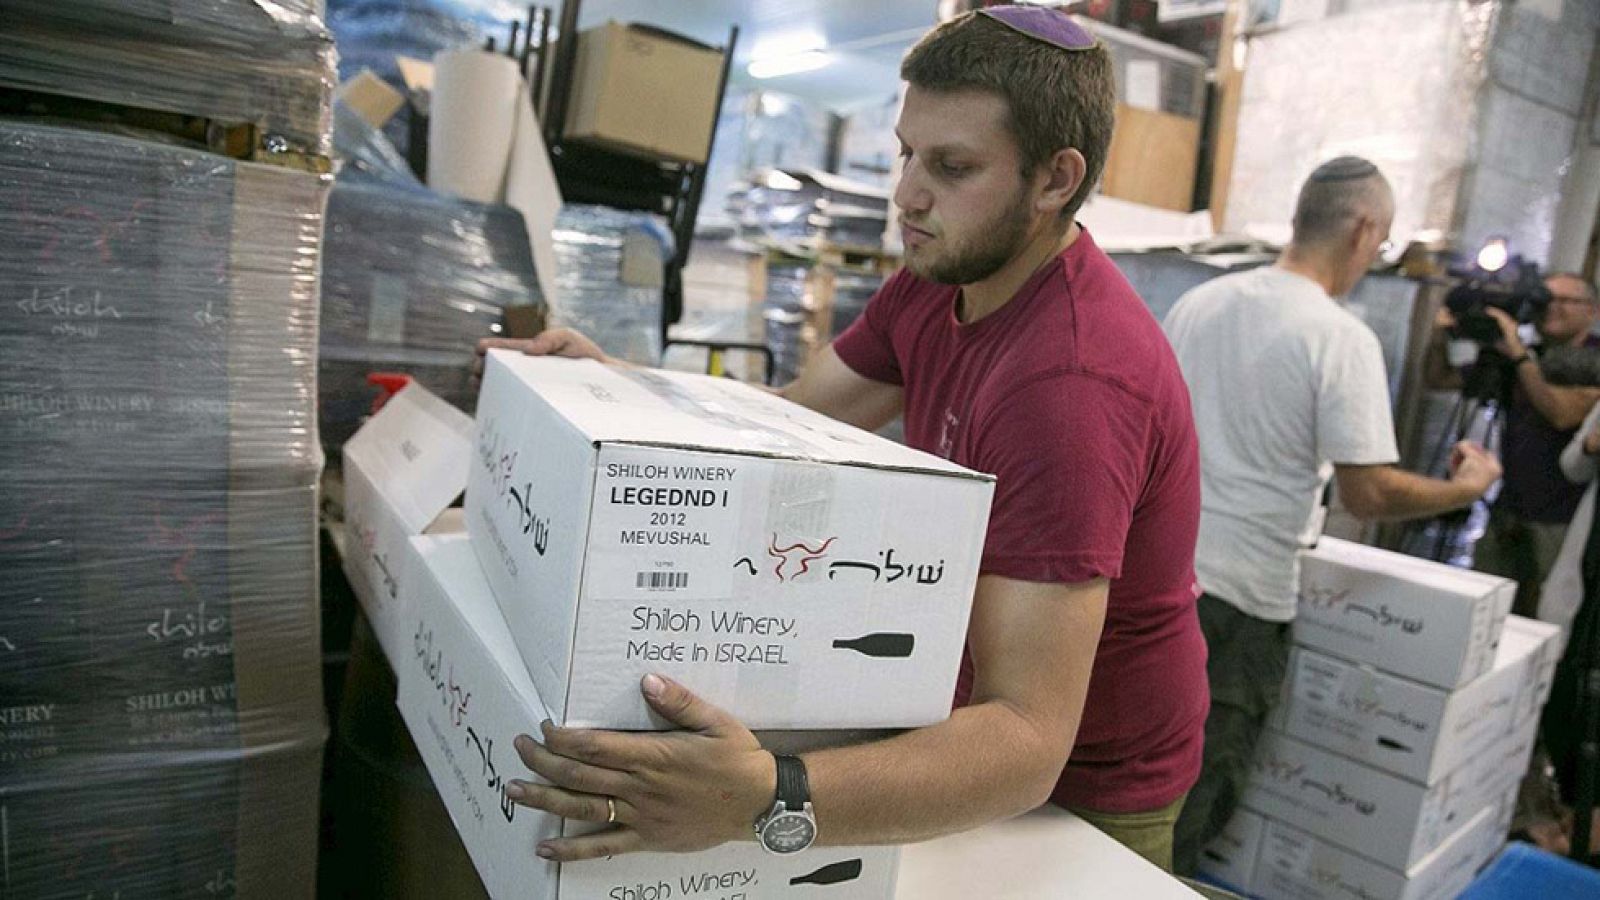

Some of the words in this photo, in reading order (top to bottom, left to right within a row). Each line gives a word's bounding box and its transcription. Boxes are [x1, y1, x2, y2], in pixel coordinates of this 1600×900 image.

[606, 463, 669, 479] SHILOH
[673, 466, 736, 481] WINERY
[610, 486, 716, 507] LEGEDND
[722, 489, 729, 507] I
[650, 512, 686, 526] 2012
[620, 530, 711, 546] MEVUSHAL
[630, 605, 701, 632] Shiloh
[711, 610, 798, 639] Winery,
[626, 640, 685, 662] Made
[691, 643, 708, 662] In
[714, 643, 788, 665] ISRAEL
[126, 687, 207, 712] SHILOH
[679, 868, 759, 895] Winery,
